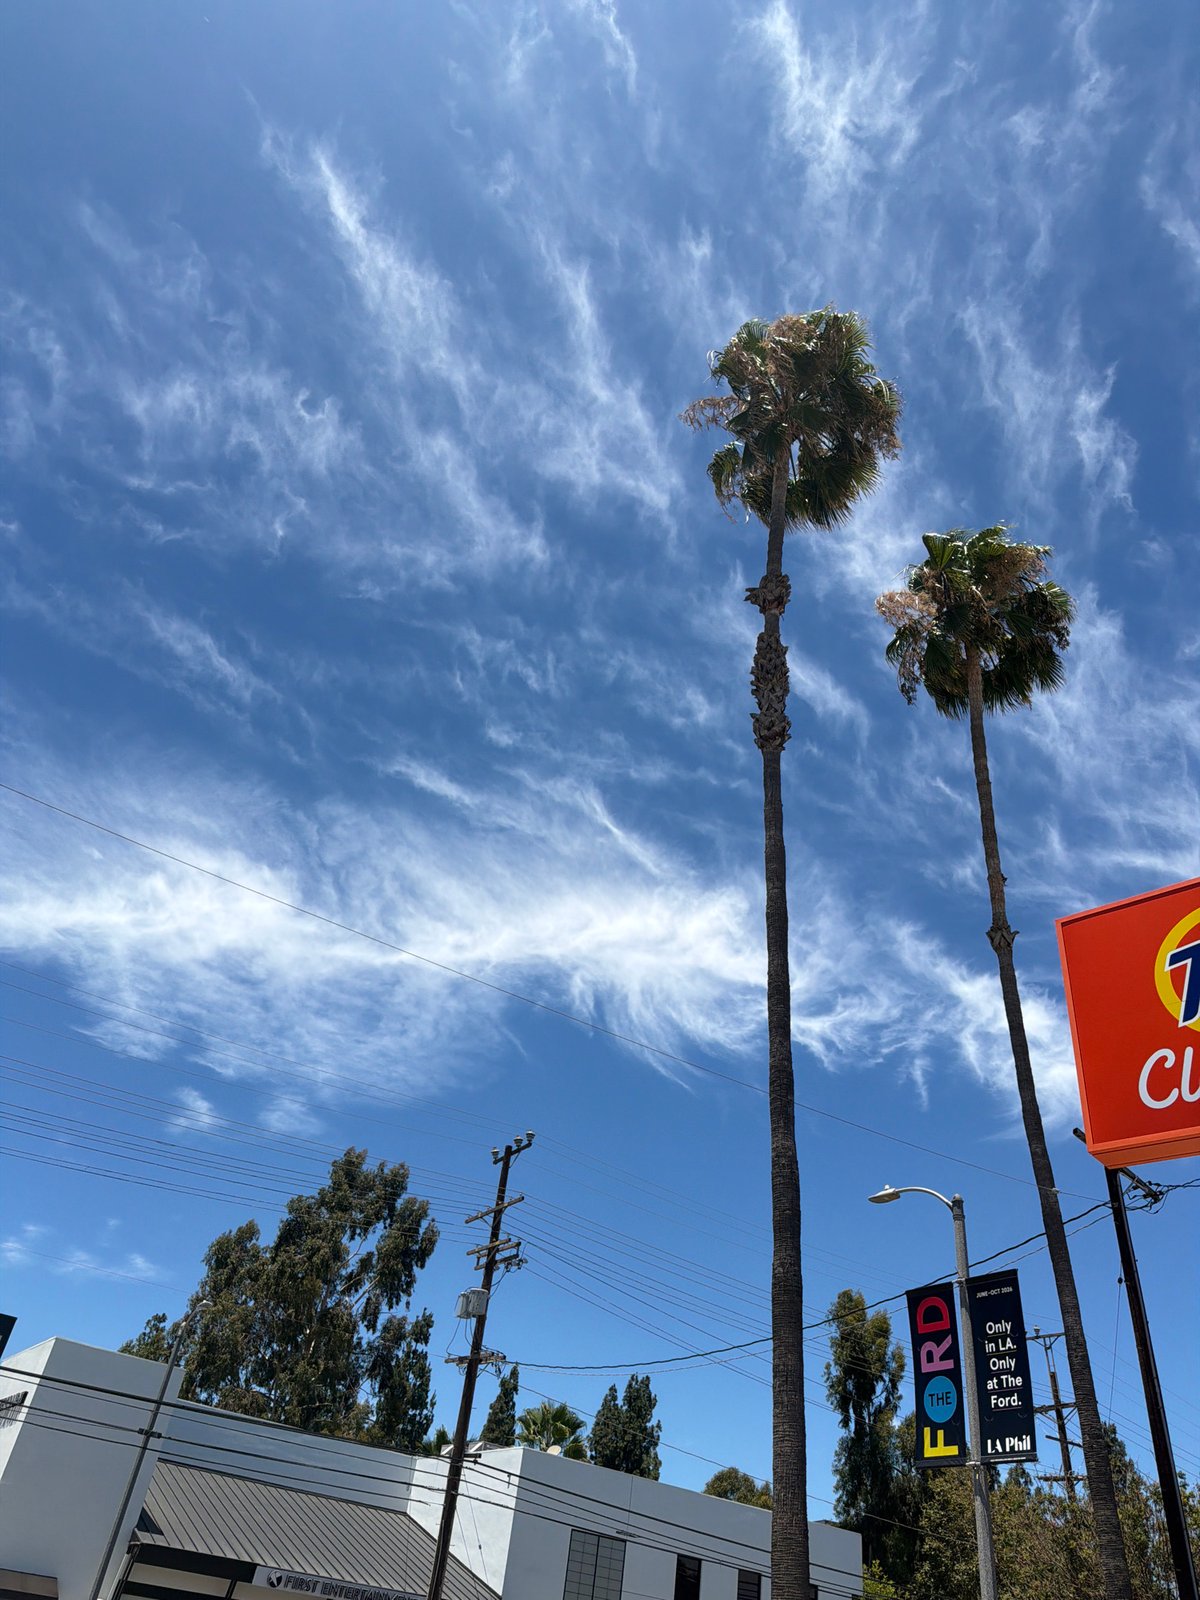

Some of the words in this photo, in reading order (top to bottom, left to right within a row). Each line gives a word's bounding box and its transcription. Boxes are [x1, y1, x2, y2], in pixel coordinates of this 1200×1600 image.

[986, 1320, 1012, 1335] Only
[985, 1341, 996, 1354] in
[998, 1337, 1017, 1351] LA.
[989, 1358, 1016, 1371] Only
[986, 1379, 999, 1390] at
[1000, 1374, 1023, 1389] The
[928, 1391, 953, 1408] THE
[991, 1393, 1022, 1408] Ford.
[987, 1438, 1003, 1454] LA
[1005, 1435, 1031, 1452] Phil
[283, 1574, 320, 1593] FIRST
